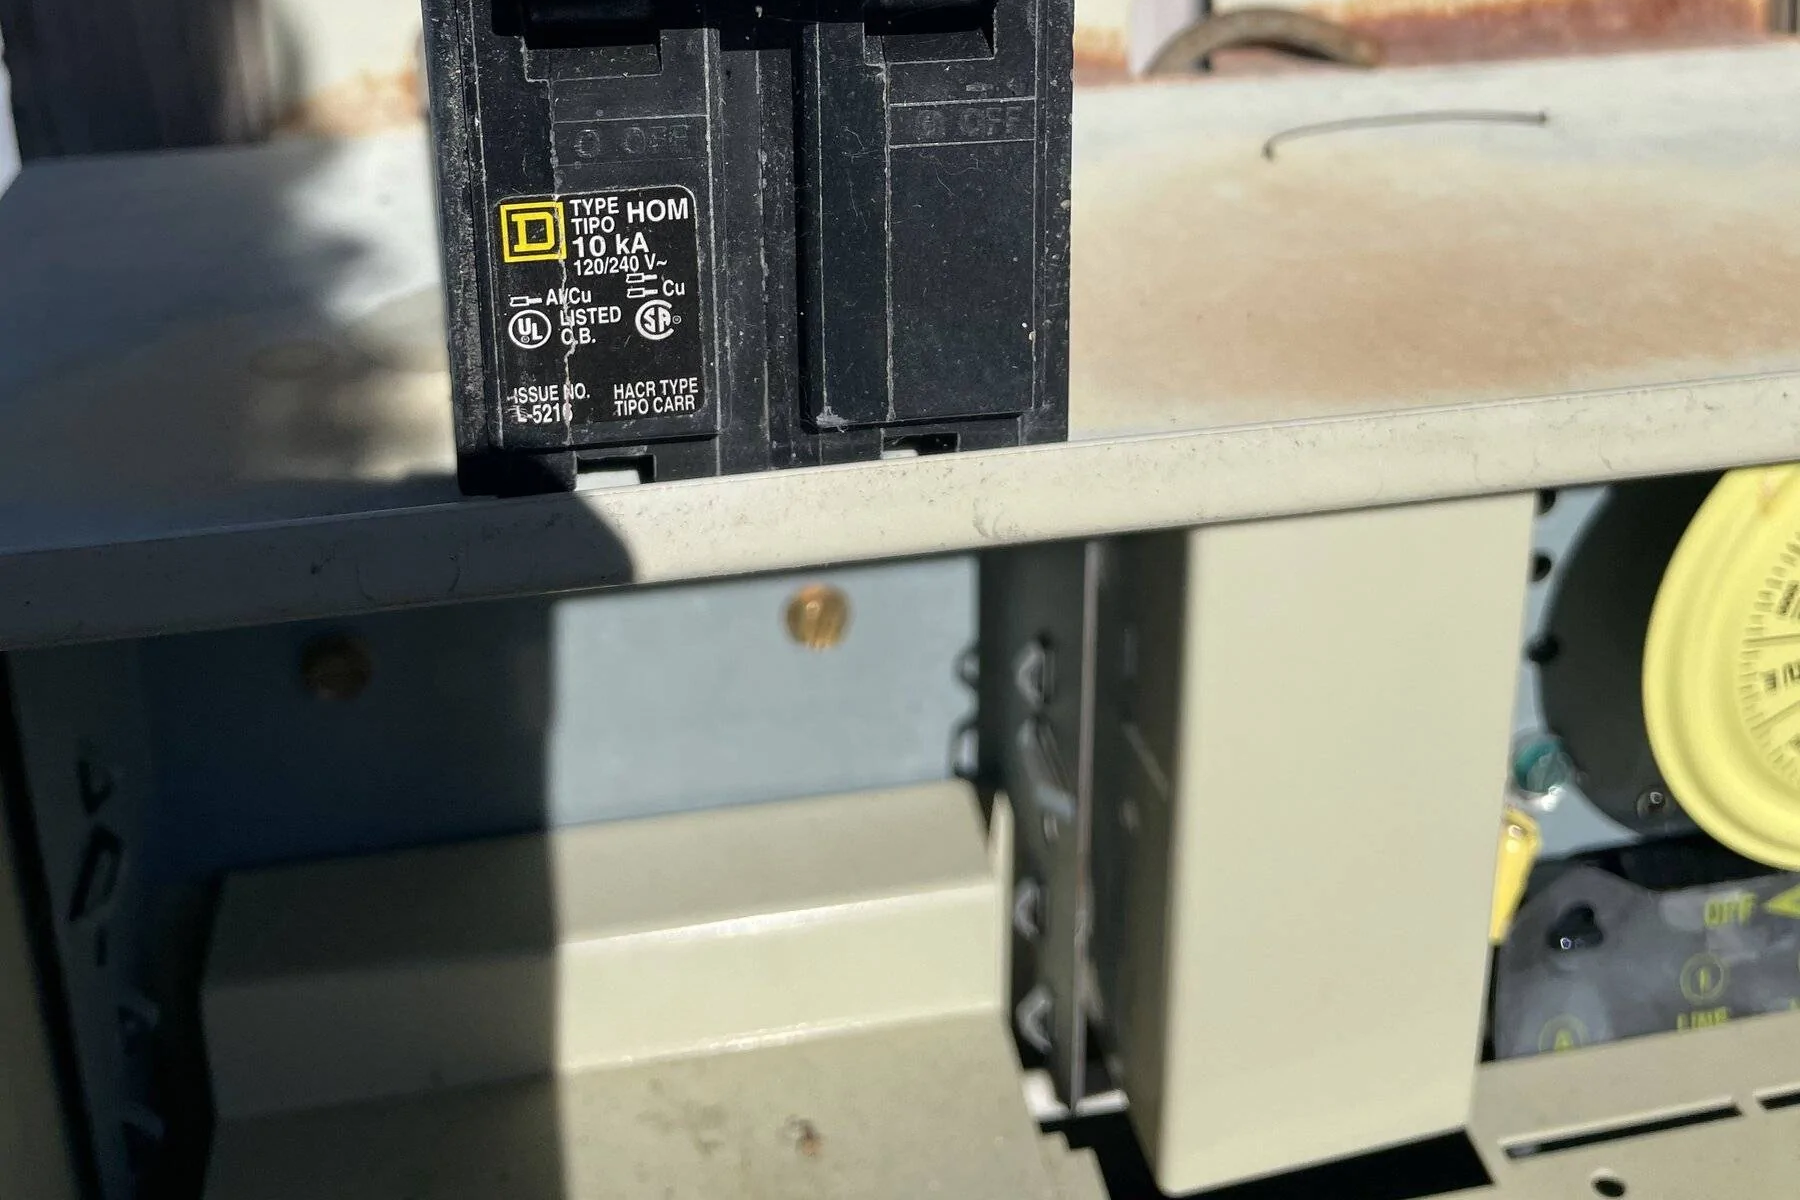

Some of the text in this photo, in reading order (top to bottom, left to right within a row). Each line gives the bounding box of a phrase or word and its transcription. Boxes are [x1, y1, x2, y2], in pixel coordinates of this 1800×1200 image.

[569, 196, 689, 224] TYPE HOM
[570, 215, 616, 236] TIPO
[572, 231, 650, 258] 10 kA
[573, 254, 640, 276] 120/240
[662, 278, 686, 297] Cu
[560, 305, 622, 326] LISTED
[513, 382, 591, 404] ISSUE NO.
[613, 377, 699, 400] HACR TYPE
[614, 394, 696, 417] TIPO CARR
